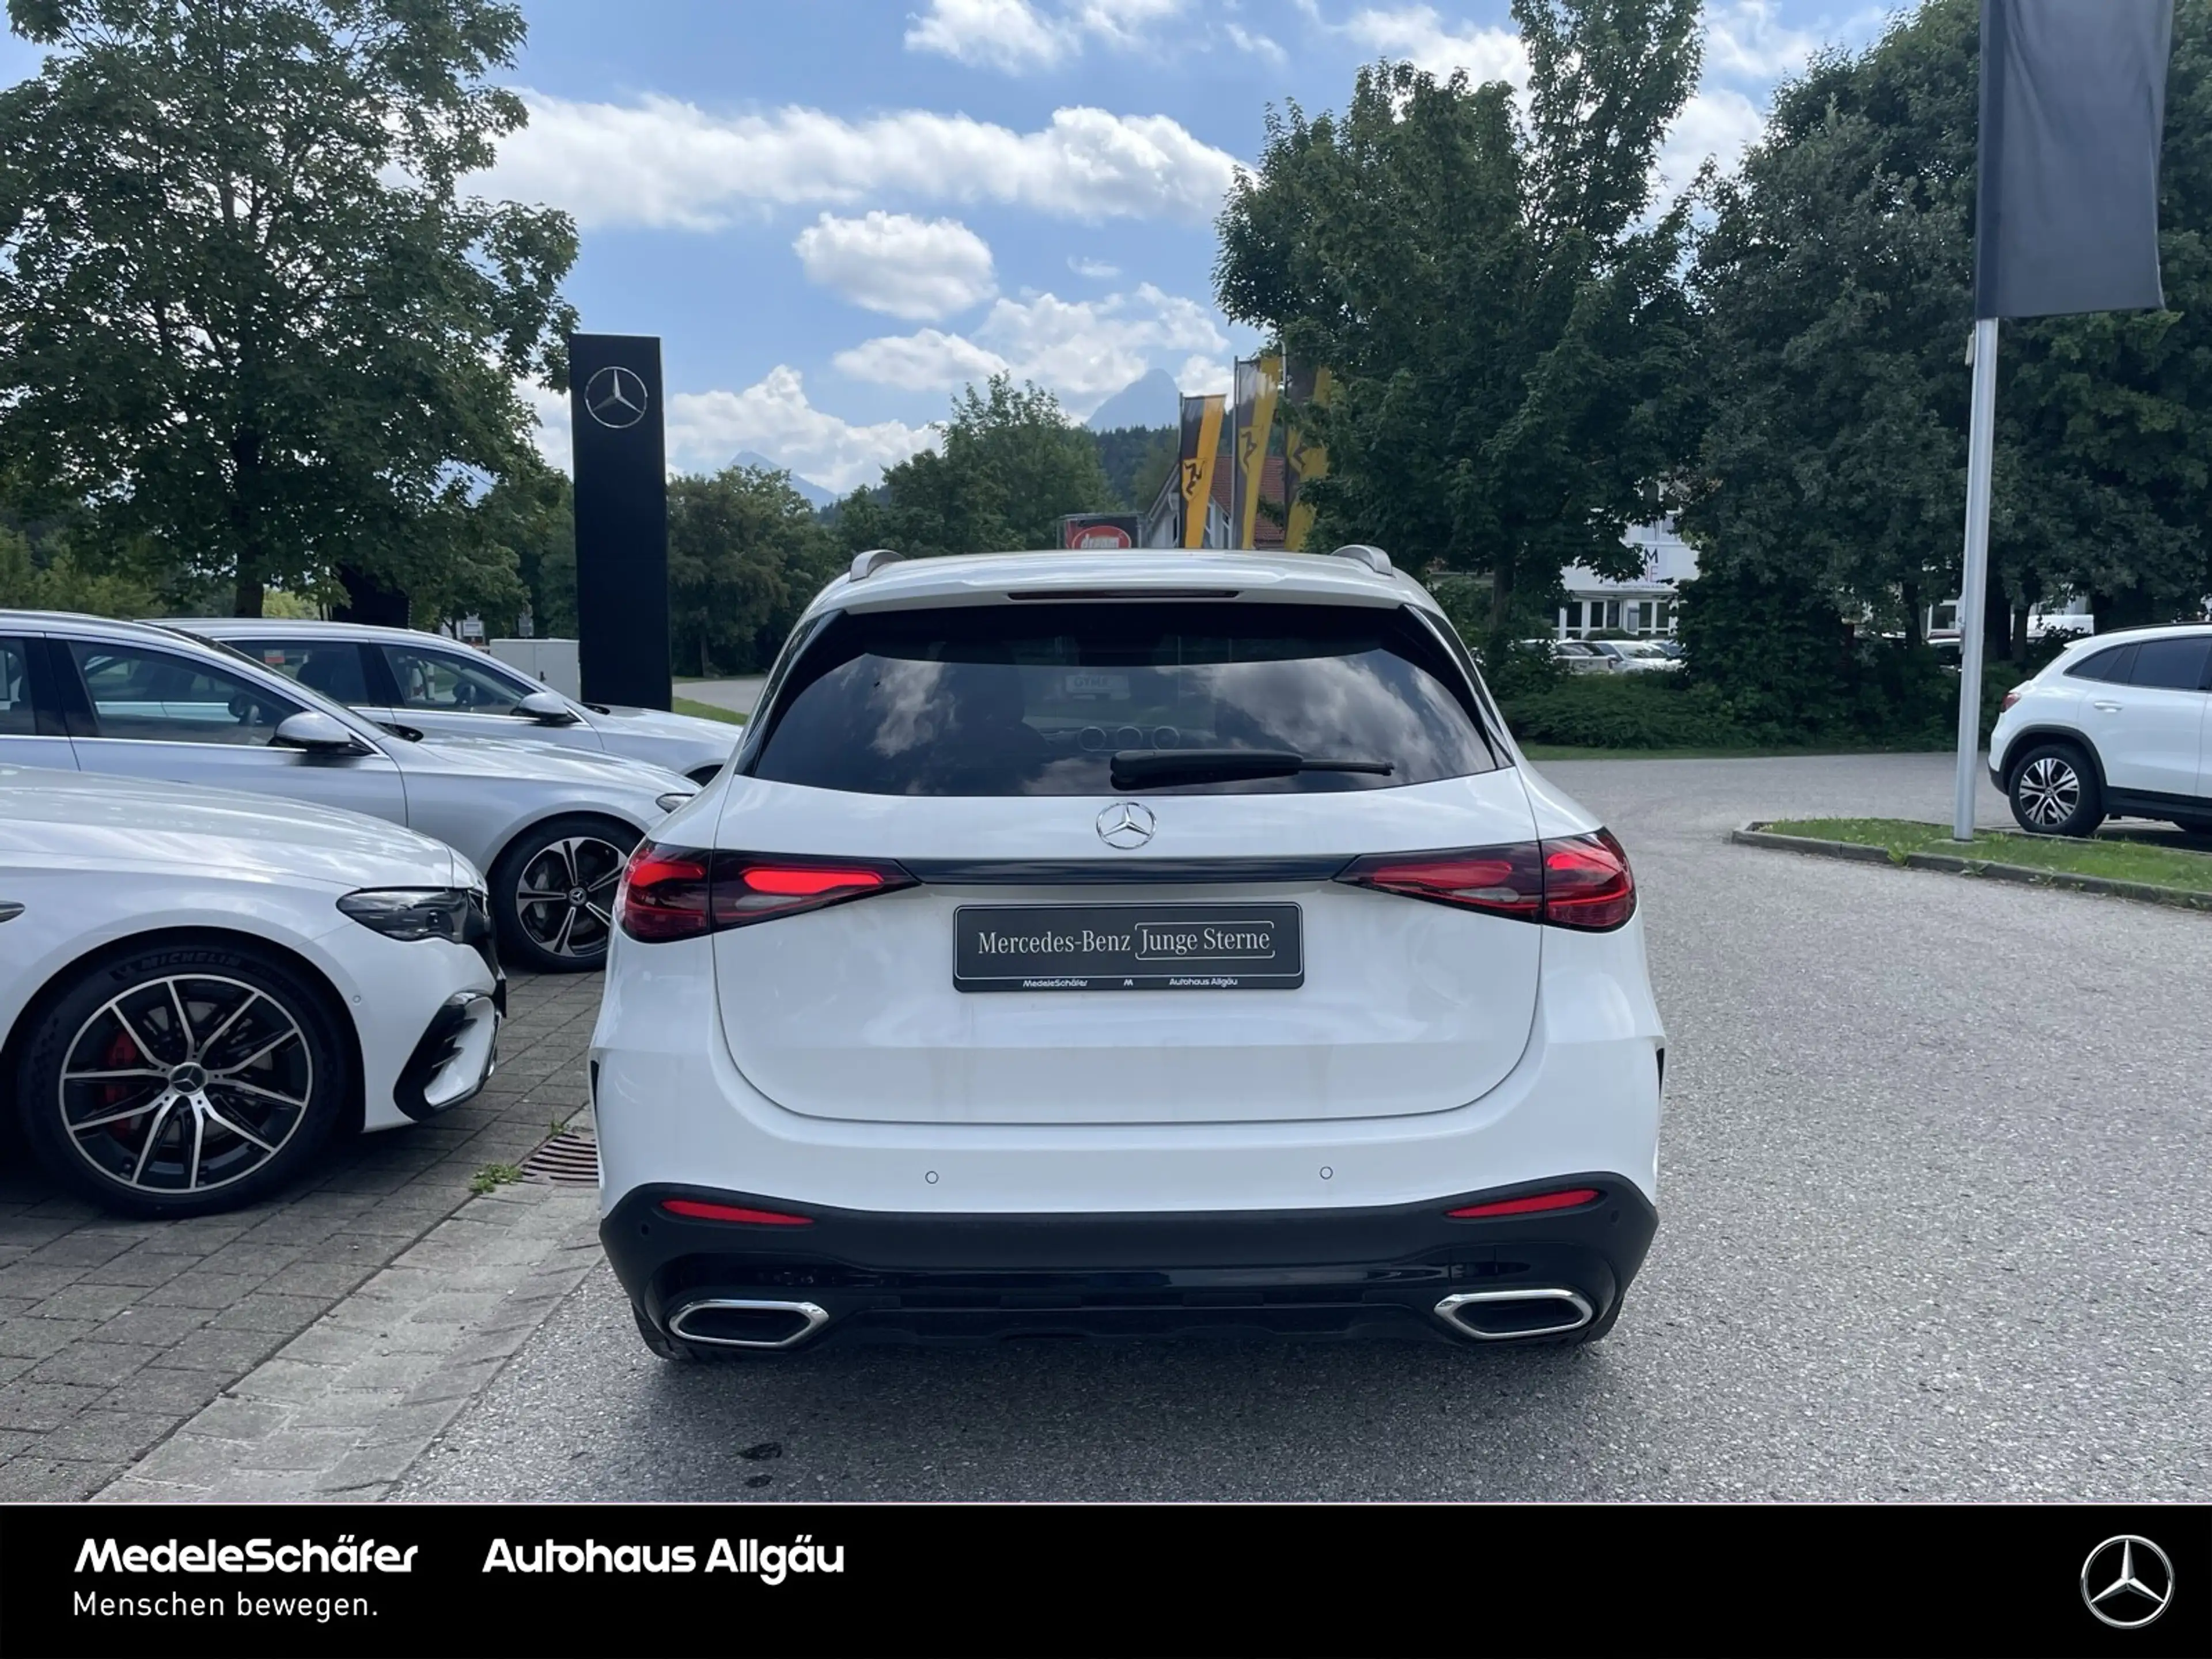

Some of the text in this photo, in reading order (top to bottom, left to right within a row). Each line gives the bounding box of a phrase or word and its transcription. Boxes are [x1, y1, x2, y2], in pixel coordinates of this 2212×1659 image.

[978, 927, 1271, 956] Mercedes-Benz Junge Sterne
[141, 952, 242, 970] MICHELIN
[1211, 978, 1238, 987] Allgäu
